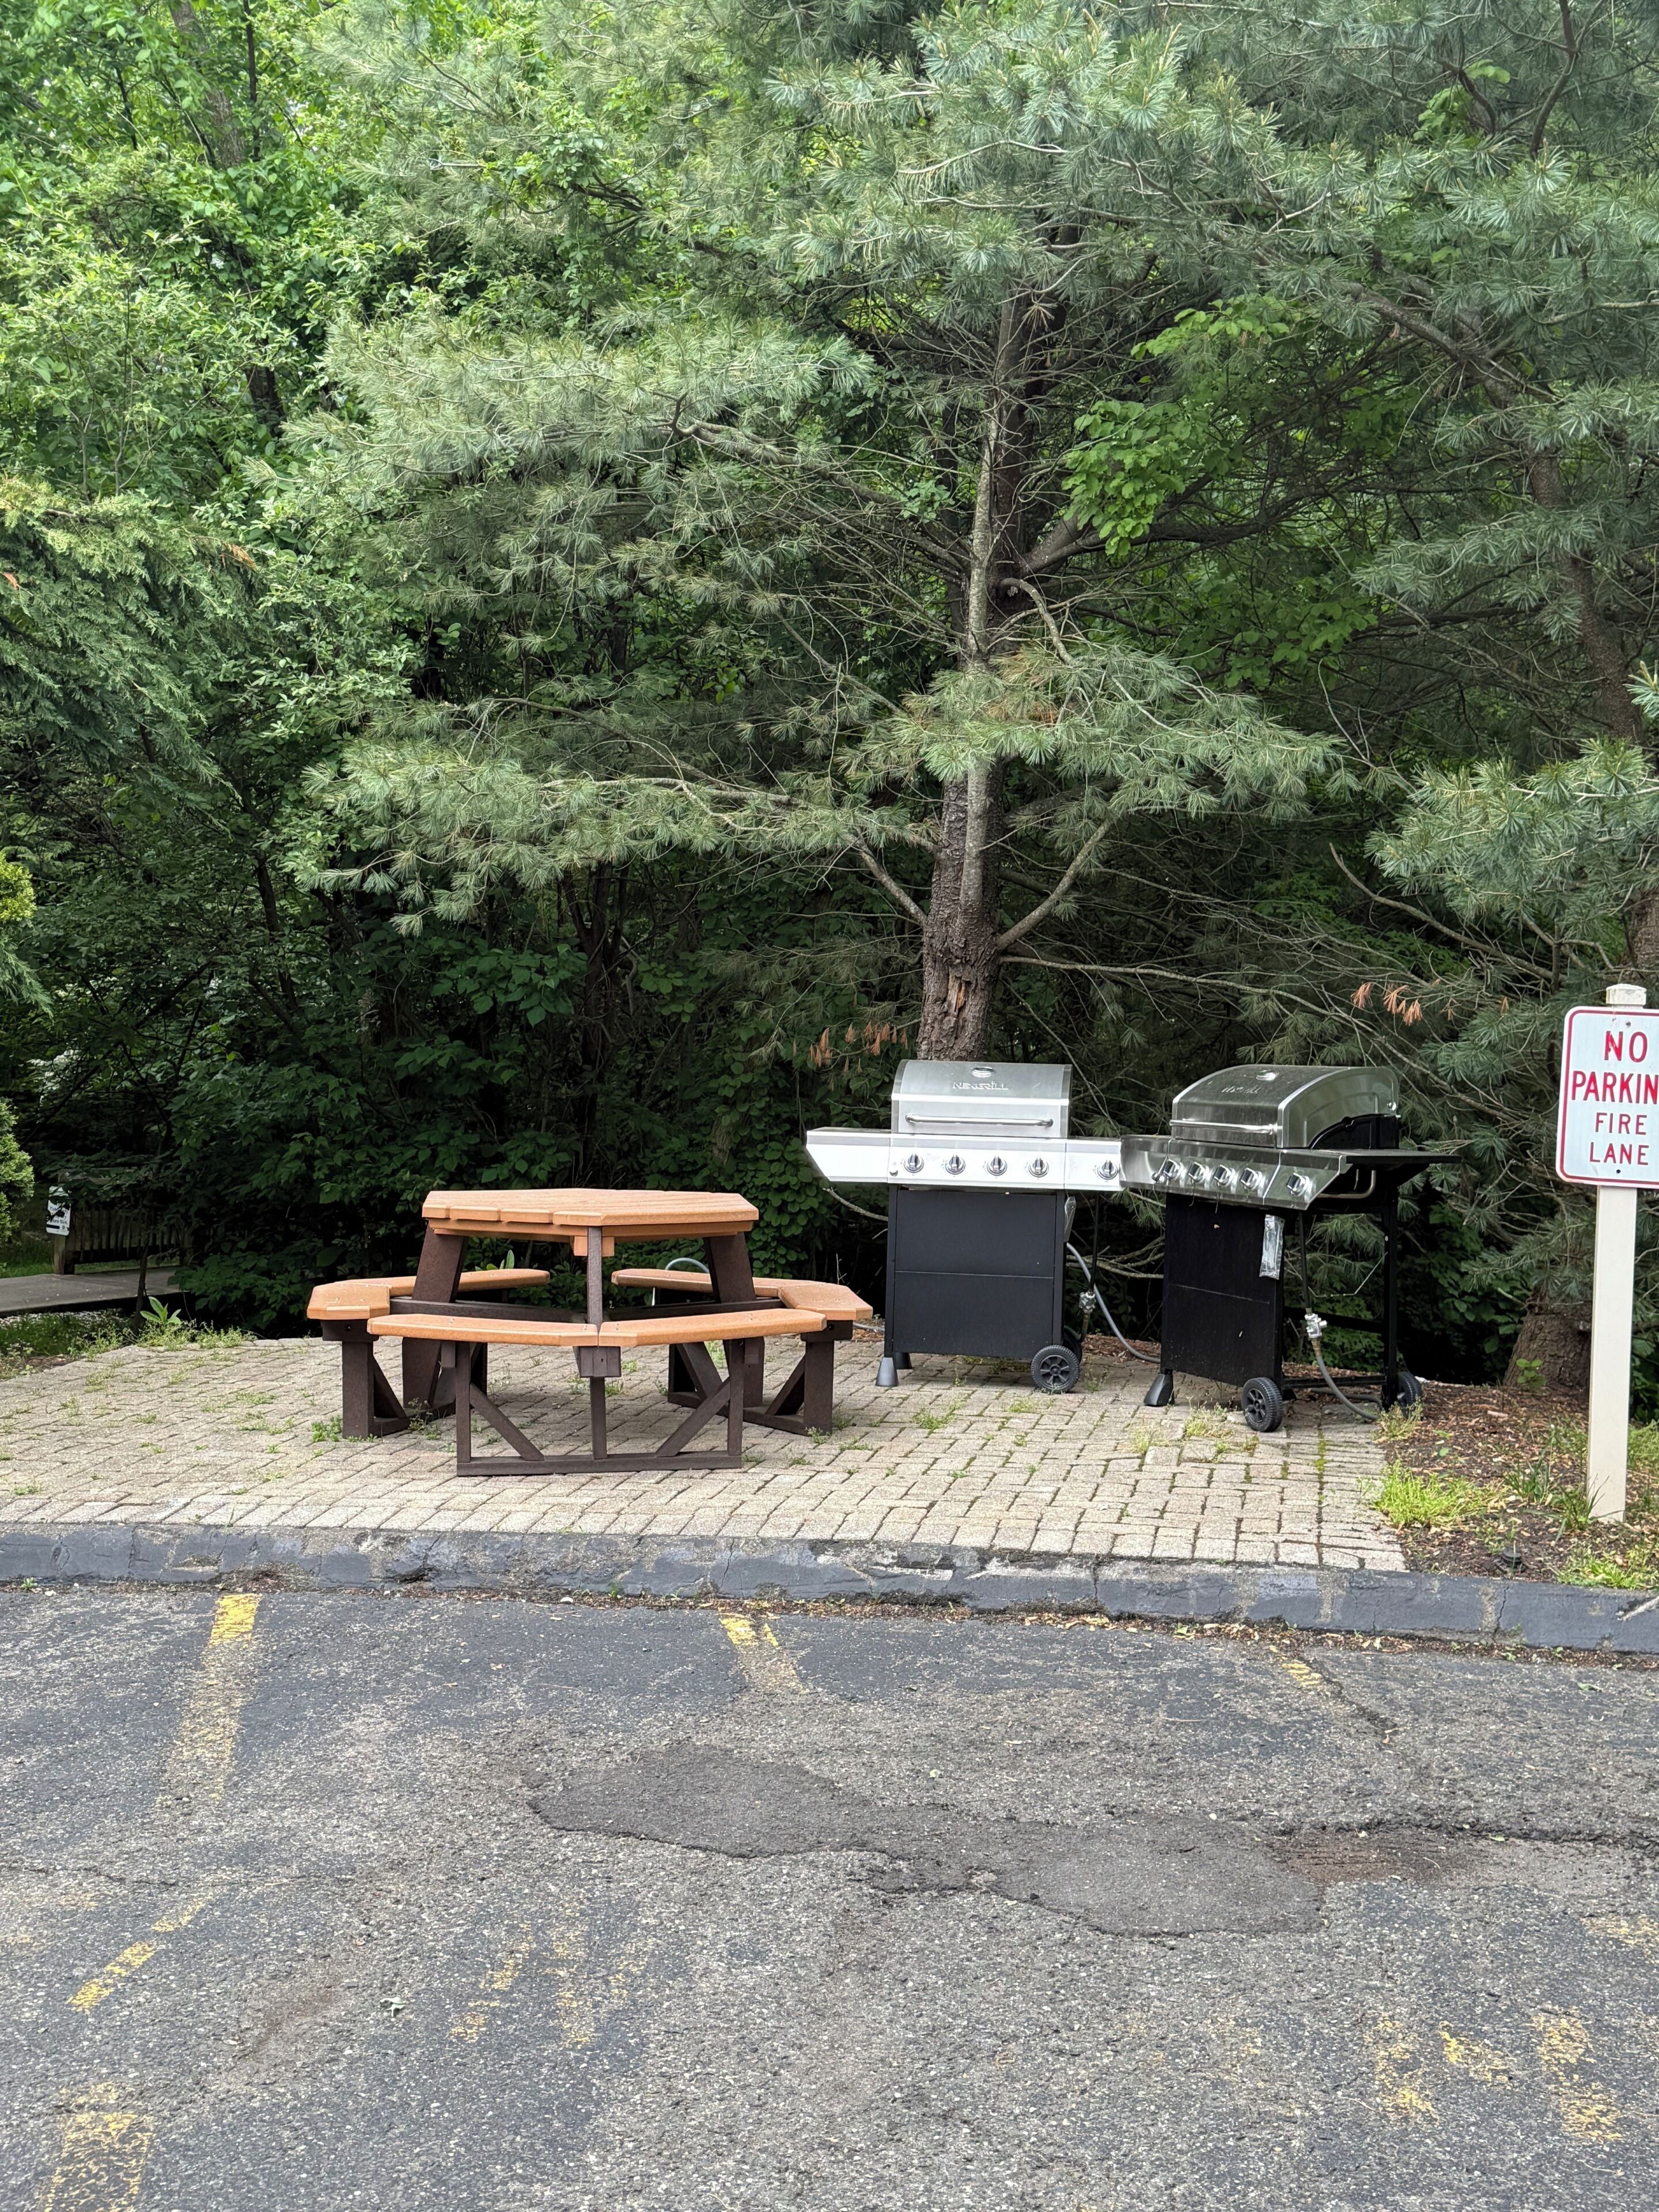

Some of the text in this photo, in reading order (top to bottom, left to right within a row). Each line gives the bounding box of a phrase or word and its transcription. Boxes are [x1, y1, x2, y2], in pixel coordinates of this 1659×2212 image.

[1604, 1031, 1647, 1063] NO
[1571, 1070, 1659, 1105] PARKIN
[1595, 1112, 1647, 1135] FIRE
[1589, 1142, 1649, 1166] LANE
